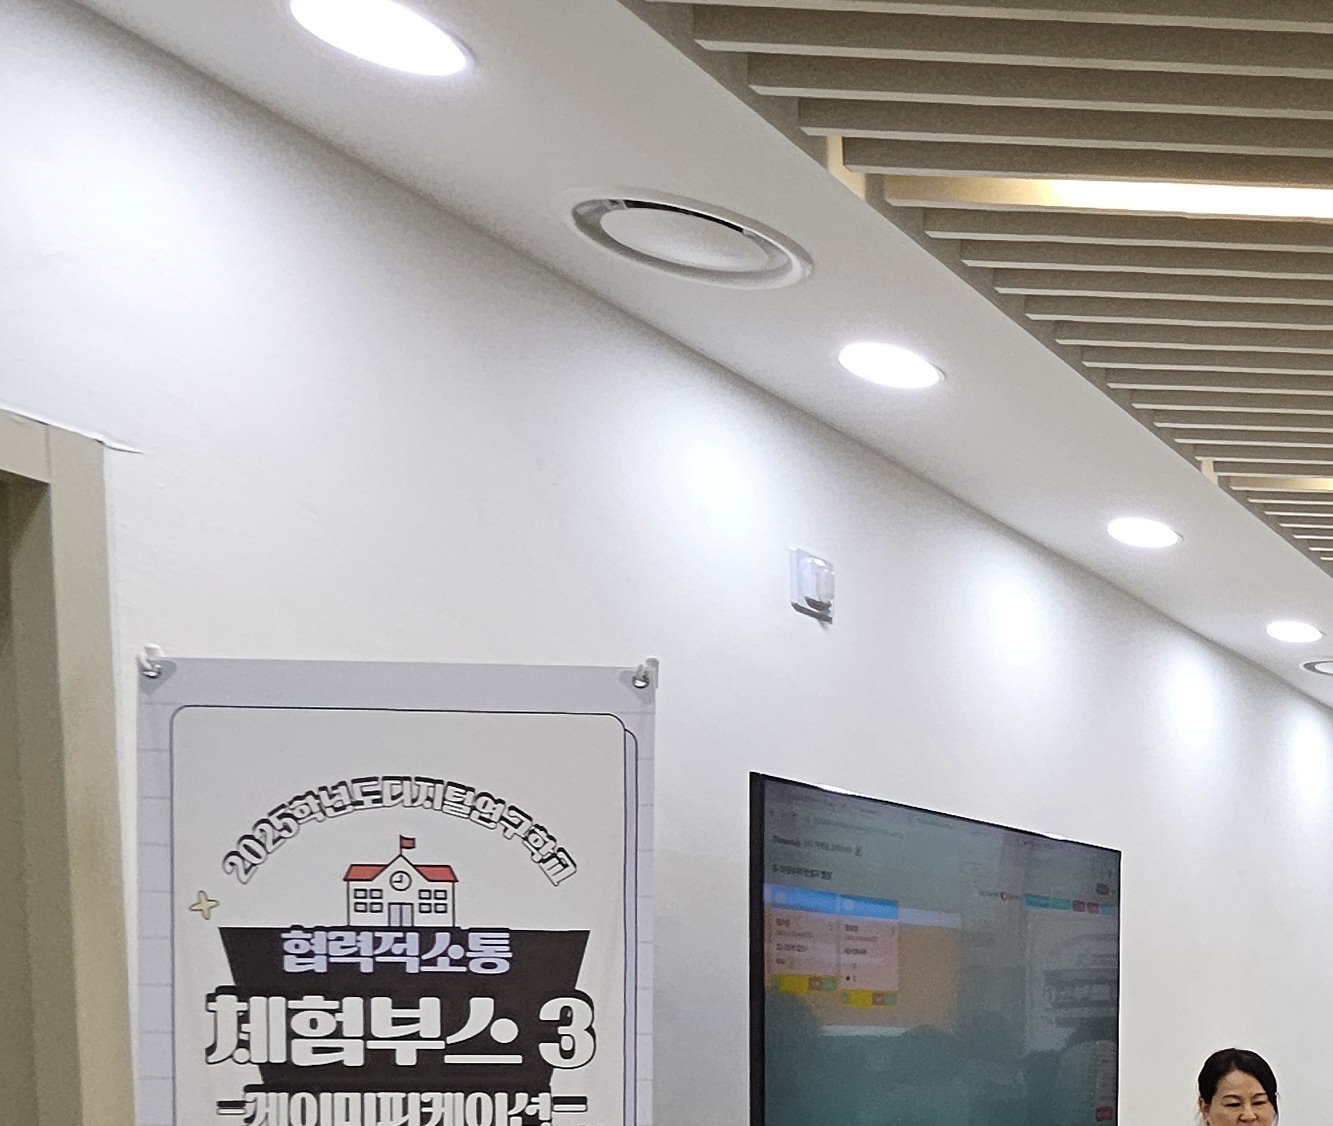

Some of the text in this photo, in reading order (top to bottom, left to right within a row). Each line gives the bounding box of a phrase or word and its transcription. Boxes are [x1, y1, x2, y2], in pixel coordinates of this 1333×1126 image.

[281, 929, 513, 974] 협력적소통
[205, 990, 597, 1069] 체험부스 3
